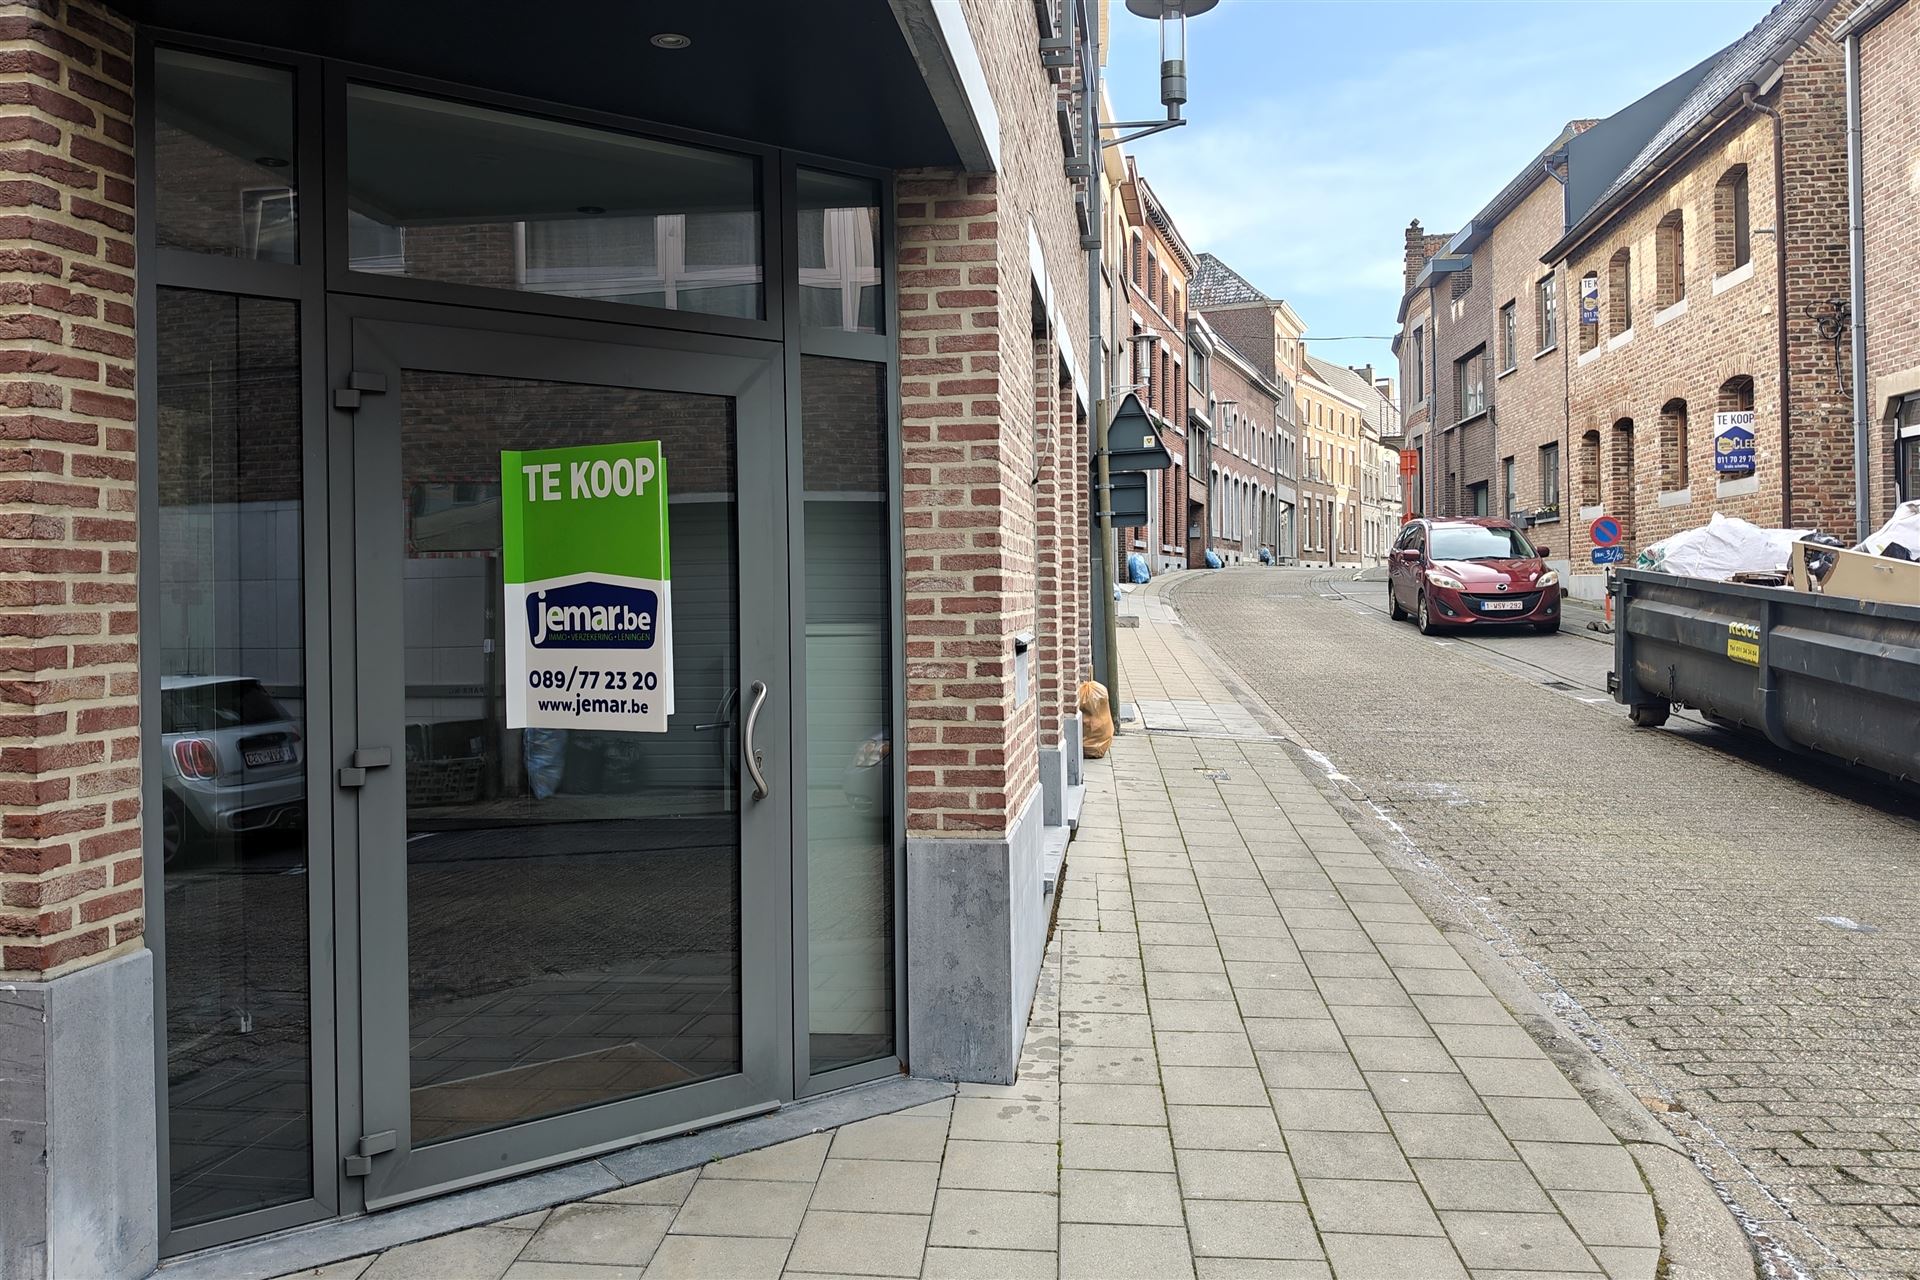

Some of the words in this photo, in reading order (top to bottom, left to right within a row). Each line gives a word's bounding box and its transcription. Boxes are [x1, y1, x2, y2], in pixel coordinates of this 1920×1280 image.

[1584, 280, 1592, 288] TE
[1717, 415, 1728, 425] TE
[1730, 413, 1755, 424] KOOP
[1717, 456, 1728, 464] 011
[1730, 455, 1738, 463] 70
[1739, 455, 1747, 463] 29
[522, 463, 561, 502] TE
[570, 457, 655, 500] KOOP
[534, 590, 651, 645] jemar.be
[548, 633, 567, 641] IMMO
[571, 633, 614, 641] VERZEKERING
[617, 633, 651, 641] LENINGEN
[529, 665, 600, 692] 089/77
[604, 671, 627, 690] 23
[632, 671, 658, 691] 20
[538, 692, 649, 716] www.jemar.be
